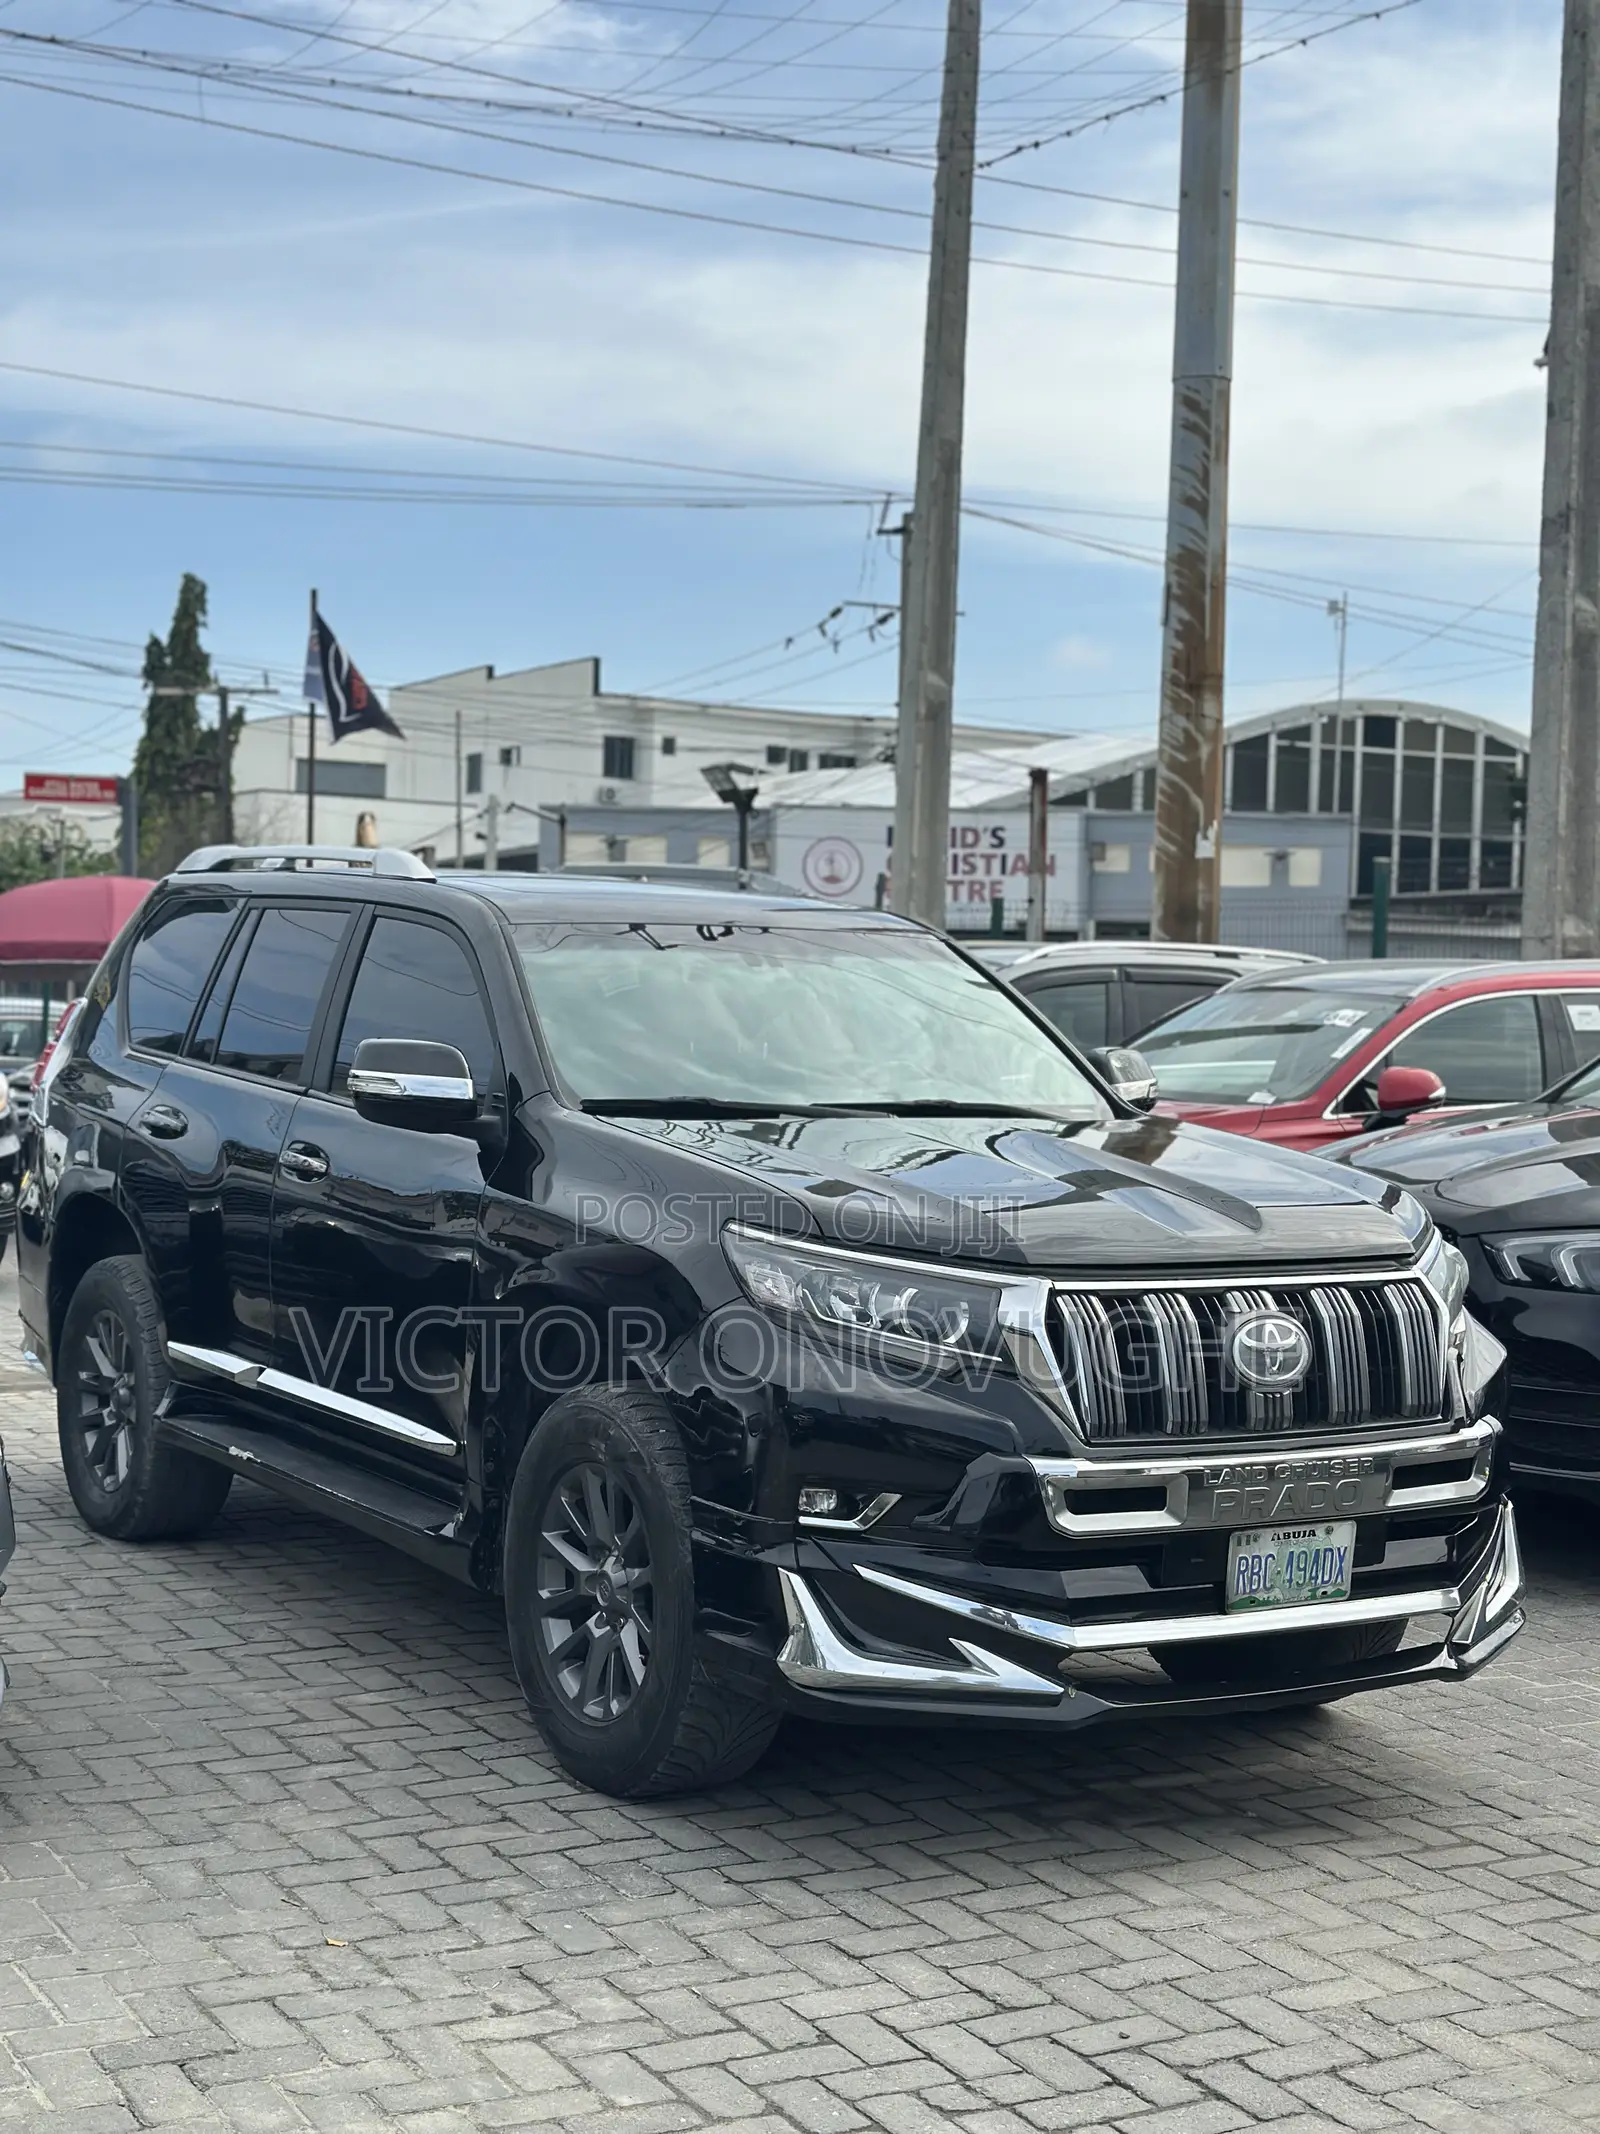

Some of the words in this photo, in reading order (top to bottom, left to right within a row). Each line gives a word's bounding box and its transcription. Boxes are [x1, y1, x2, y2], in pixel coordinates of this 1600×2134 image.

[1203, 1467, 1268, 1487] LAND
[1274, 1457, 1374, 1481] CRUISER
[1211, 1479, 1362, 1522] PRADO
[1270, 1529, 1317, 1542] ABUJA
